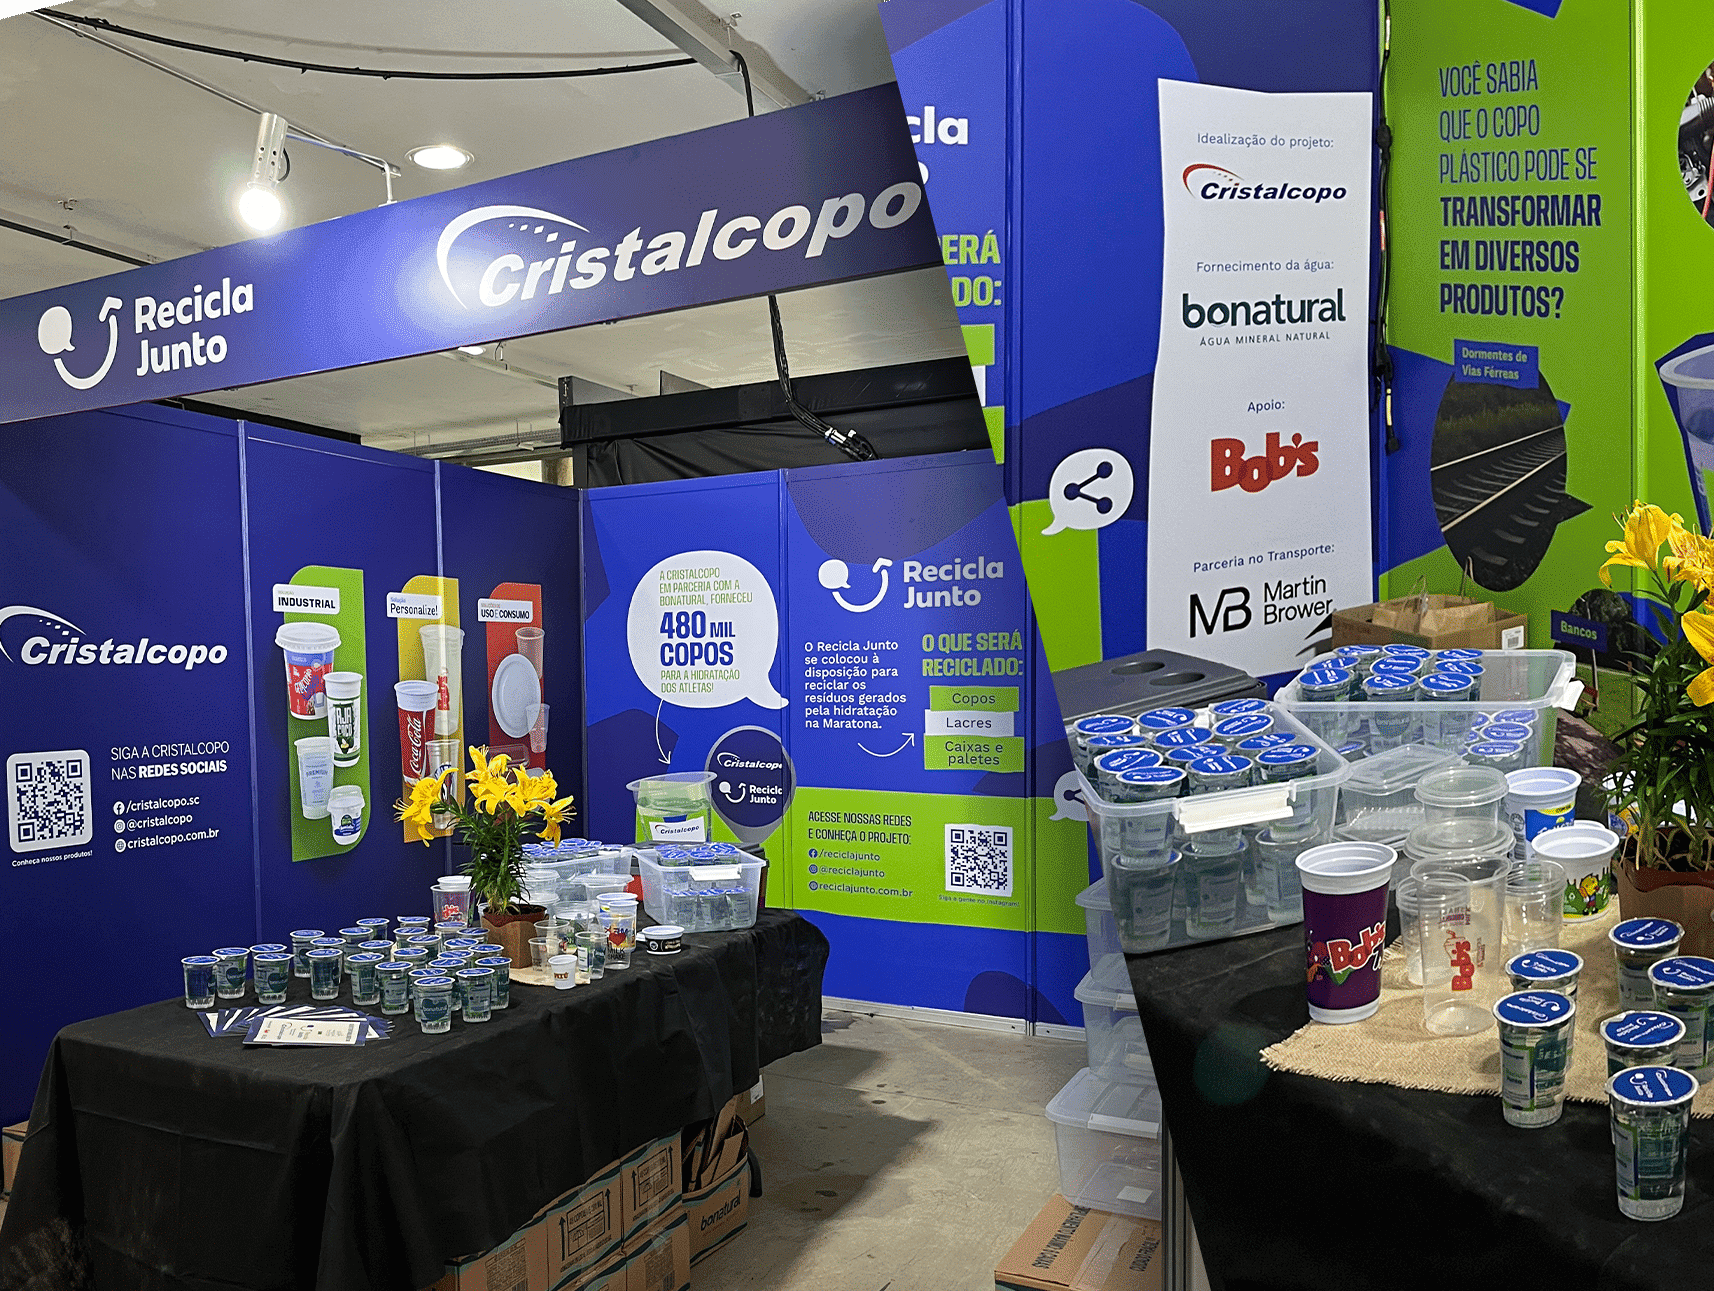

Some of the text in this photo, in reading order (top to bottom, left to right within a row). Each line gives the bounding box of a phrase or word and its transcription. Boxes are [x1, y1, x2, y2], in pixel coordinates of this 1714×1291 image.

[1439, 59, 1538, 98] VOCÊ SABIA
[1439, 105, 1540, 142] QUE O COPO
[1197, 133, 1334, 149] Idealização do projeto:
[1439, 147, 1597, 184] PLÁSTICO PODE SE
[1201, 182, 1347, 203] Cristalcopo
[1440, 194, 1602, 227] TRANSFORMAR
[478, 179, 924, 308] Cristalcopo
[1440, 240, 1580, 273] EM DIVERSOS
[1197, 258, 1334, 273] Fornecimento da água:
[134, 277, 255, 336] Recicla
[1182, 288, 1346, 329] bonatural
[1440, 282, 1564, 319] PRODUTOS?
[1200, 331, 1330, 346] ÁGUA MINERAL NATURAL
[136, 332, 228, 378] Junto
[1462, 347, 1528, 363] Dormentes de
[1462, 365, 1519, 380] Vias Férreas
[1248, 400, 1286, 414] Apoio:
[1211, 432, 1319, 493] Bob's
[1194, 544, 1335, 573] Parceria no Transporte:
[660, 567, 720, 580] A CRISTALCOPO
[903, 556, 1004, 583] Recicla
[660, 580, 740, 593] EM PARCERIA COM A
[1264, 575, 1326, 602] Martin
[278, 597, 336, 609] INDUSTRIAL
[660, 592, 753, 606] BONATURAL, FORNECEU
[903, 586, 981, 609] Junto
[390, 603, 438, 616] Personalize!
[481, 609, 494, 618] USO
[499, 609, 530, 619] CONSUMO
[1264, 598, 1333, 625] Brower
[660, 611, 735, 639] 480 MIL
[1561, 620, 1597, 640] Bancos
[805, 640, 898, 652] O Recicla Junto
[922, 629, 1022, 654] O QUE SERÁ
[20, 636, 228, 670] Cristalcopo
[660, 641, 733, 666] COPOS
[805, 653, 879, 665] se colocou à
[805, 666, 898, 680] disposição para
[922, 657, 1023, 676] RECICLADO:
[661, 669, 739, 682] PARA A HIDRATAÇÃO
[661, 682, 714, 693] DOS ATLETAS!
[805, 679, 866, 690] reciclar os
[805, 692, 906, 705] resíduos gerados
[952, 693, 996, 707] Copos
[805, 705, 897, 719] pela hidratação
[805, 718, 882, 729] na Maratona.
[946, 717, 992, 729] Lacres
[110, 741, 229, 761] SIGA A CRISTALCOPO
[945, 740, 1003, 753] Caixas e
[948, 754, 1000, 766] paletes
[111, 760, 227, 780] NAS REDES SOCIAIS
[126, 795, 200, 814] /cristalcopo.sc
[750, 795, 776, 804] Junto
[127, 813, 193, 832] @cristalcopo
[808, 811, 911, 827] ACESSE NOSSAS REDES
[660, 825, 699, 834] Cristalcopo
[808, 828, 911, 845] E CONHEÇA O PROJETO:
[127, 828, 219, 850] cristalcopo.com.br
[12, 850, 93, 867] Conheça nossos produtos!
[819, 849, 880, 862] /reciclajunto
[820, 865, 885, 878] @reciclajunto
[819, 882, 913, 898] reciclajunto.com.br
[700, 1189, 741, 1231] bonatural
